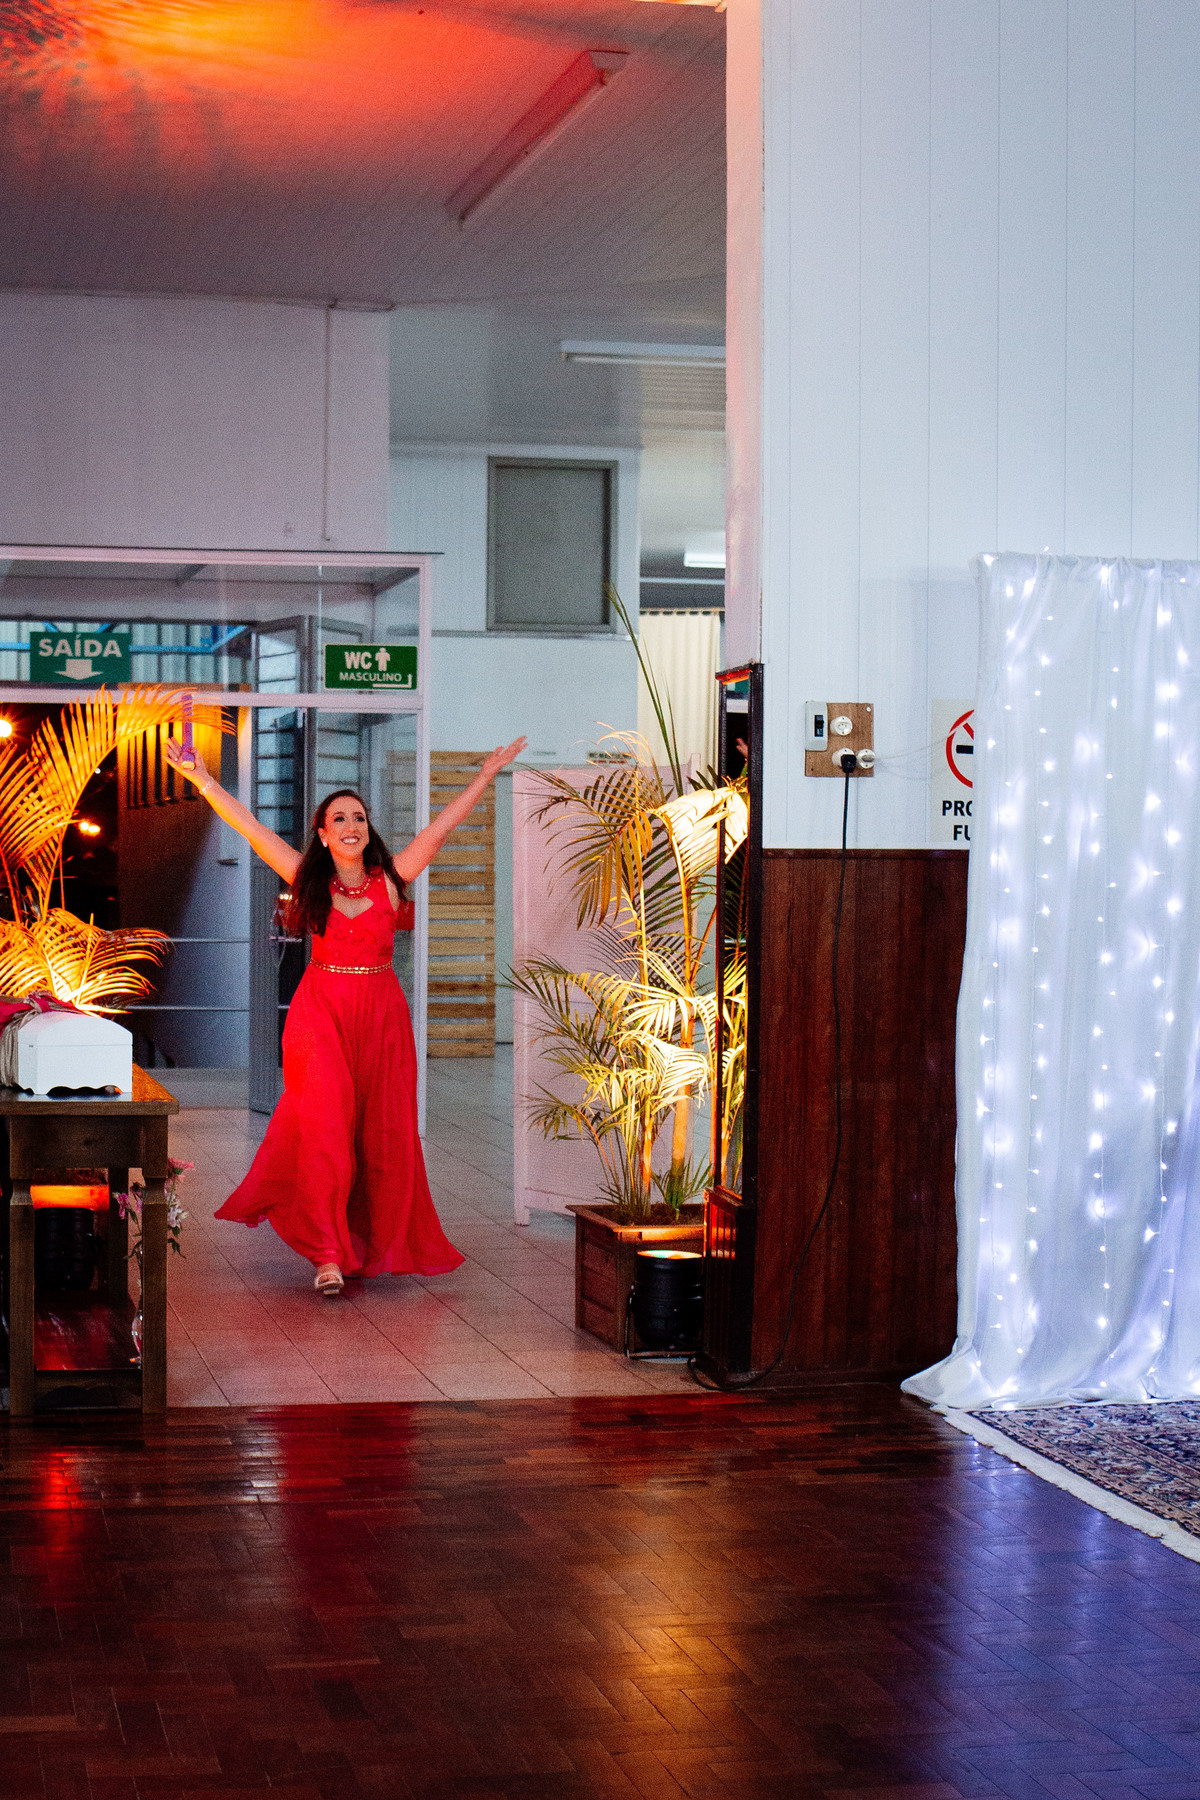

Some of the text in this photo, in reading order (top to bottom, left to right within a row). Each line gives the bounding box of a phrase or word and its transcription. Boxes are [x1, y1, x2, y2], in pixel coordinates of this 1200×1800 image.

[39, 634, 122, 658] SAÍDA
[344, 651, 372, 670] WC
[340, 672, 402, 682] MASCULINO
